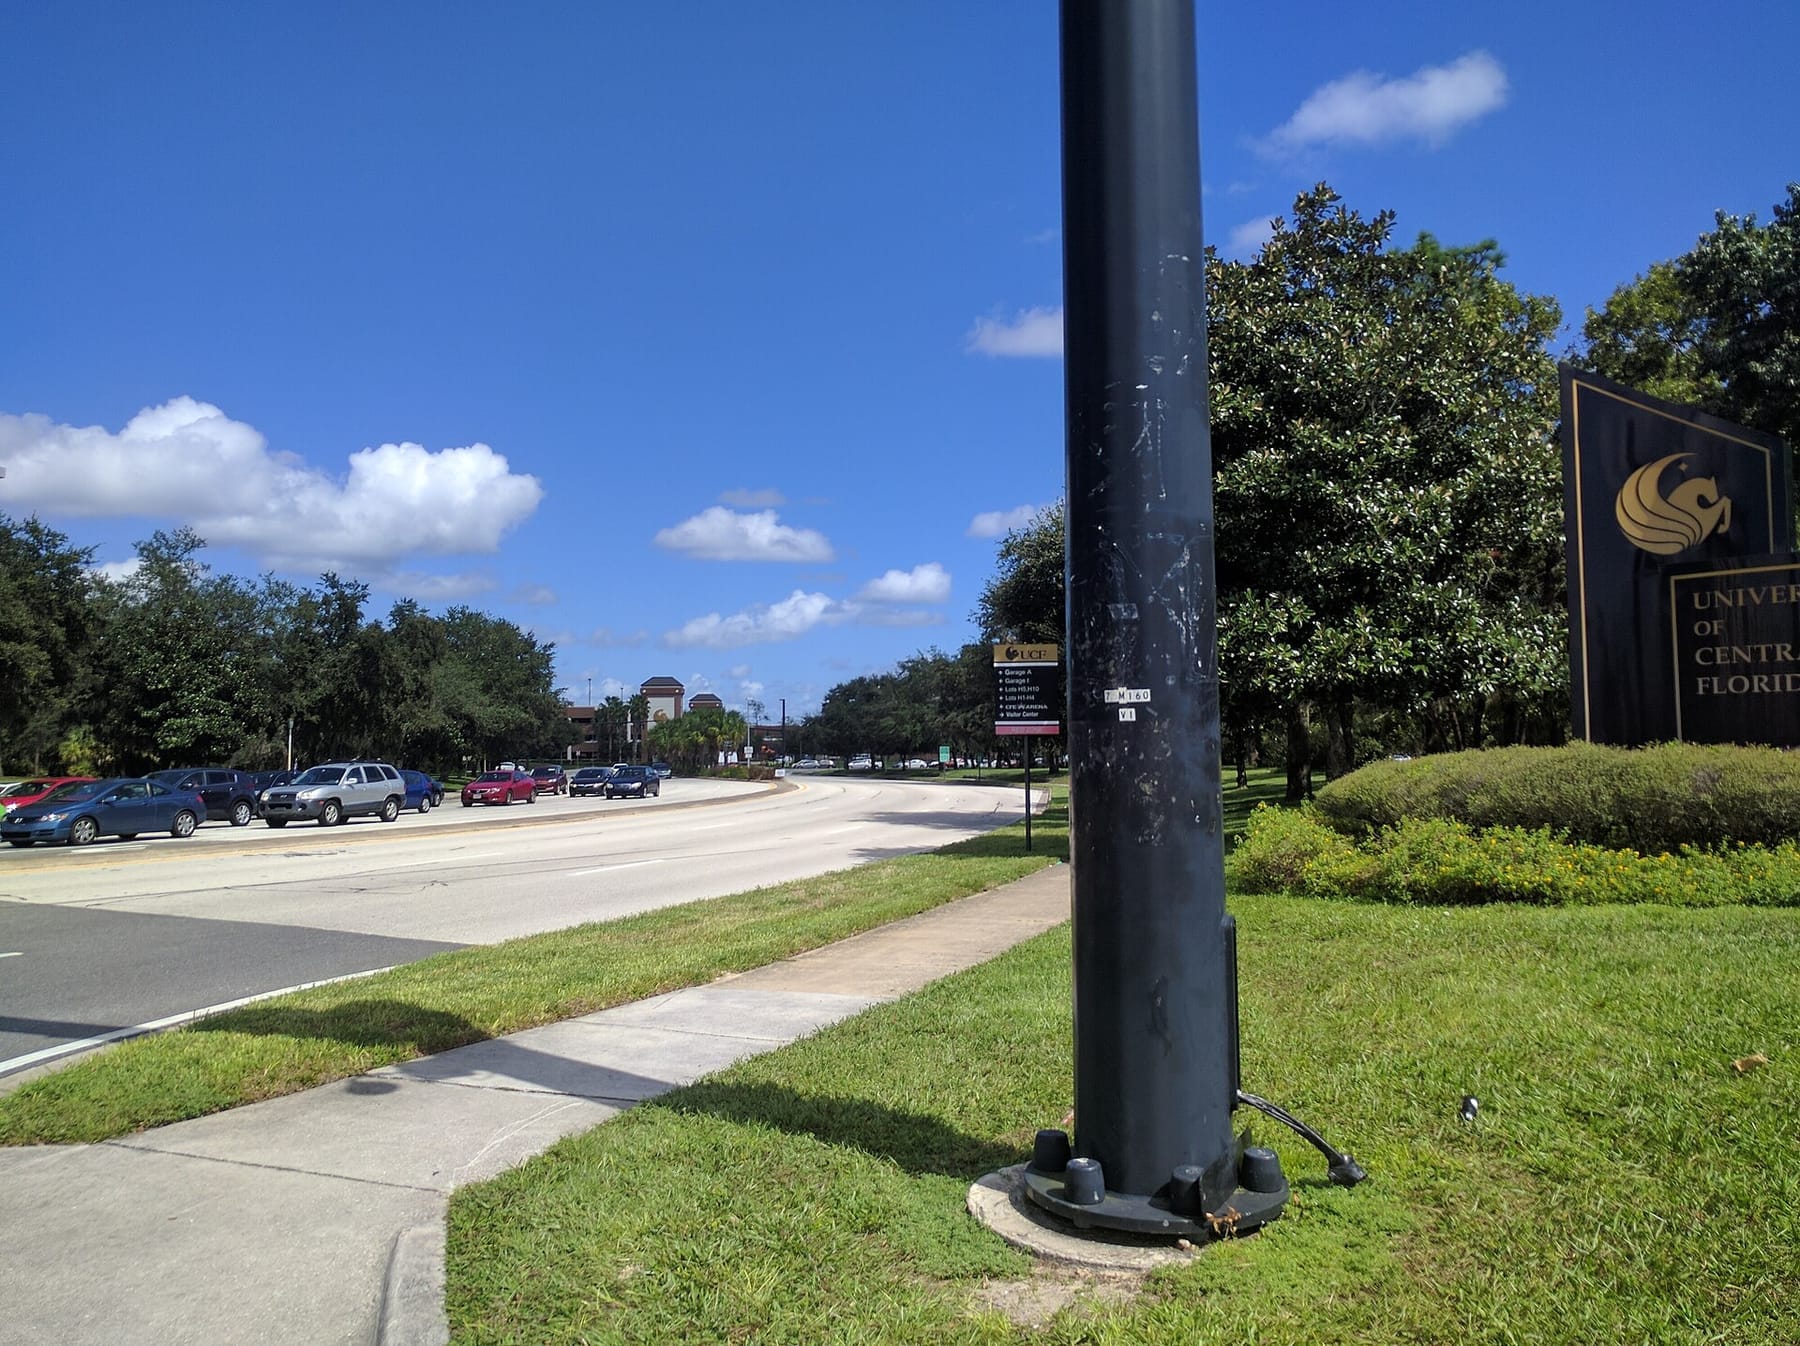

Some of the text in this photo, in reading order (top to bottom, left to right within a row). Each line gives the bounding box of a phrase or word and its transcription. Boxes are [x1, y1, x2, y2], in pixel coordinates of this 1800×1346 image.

[1693, 619, 1724, 636] OF
[1021, 650, 1047, 659] UCF
[1695, 643, 1800, 665] CENTR
